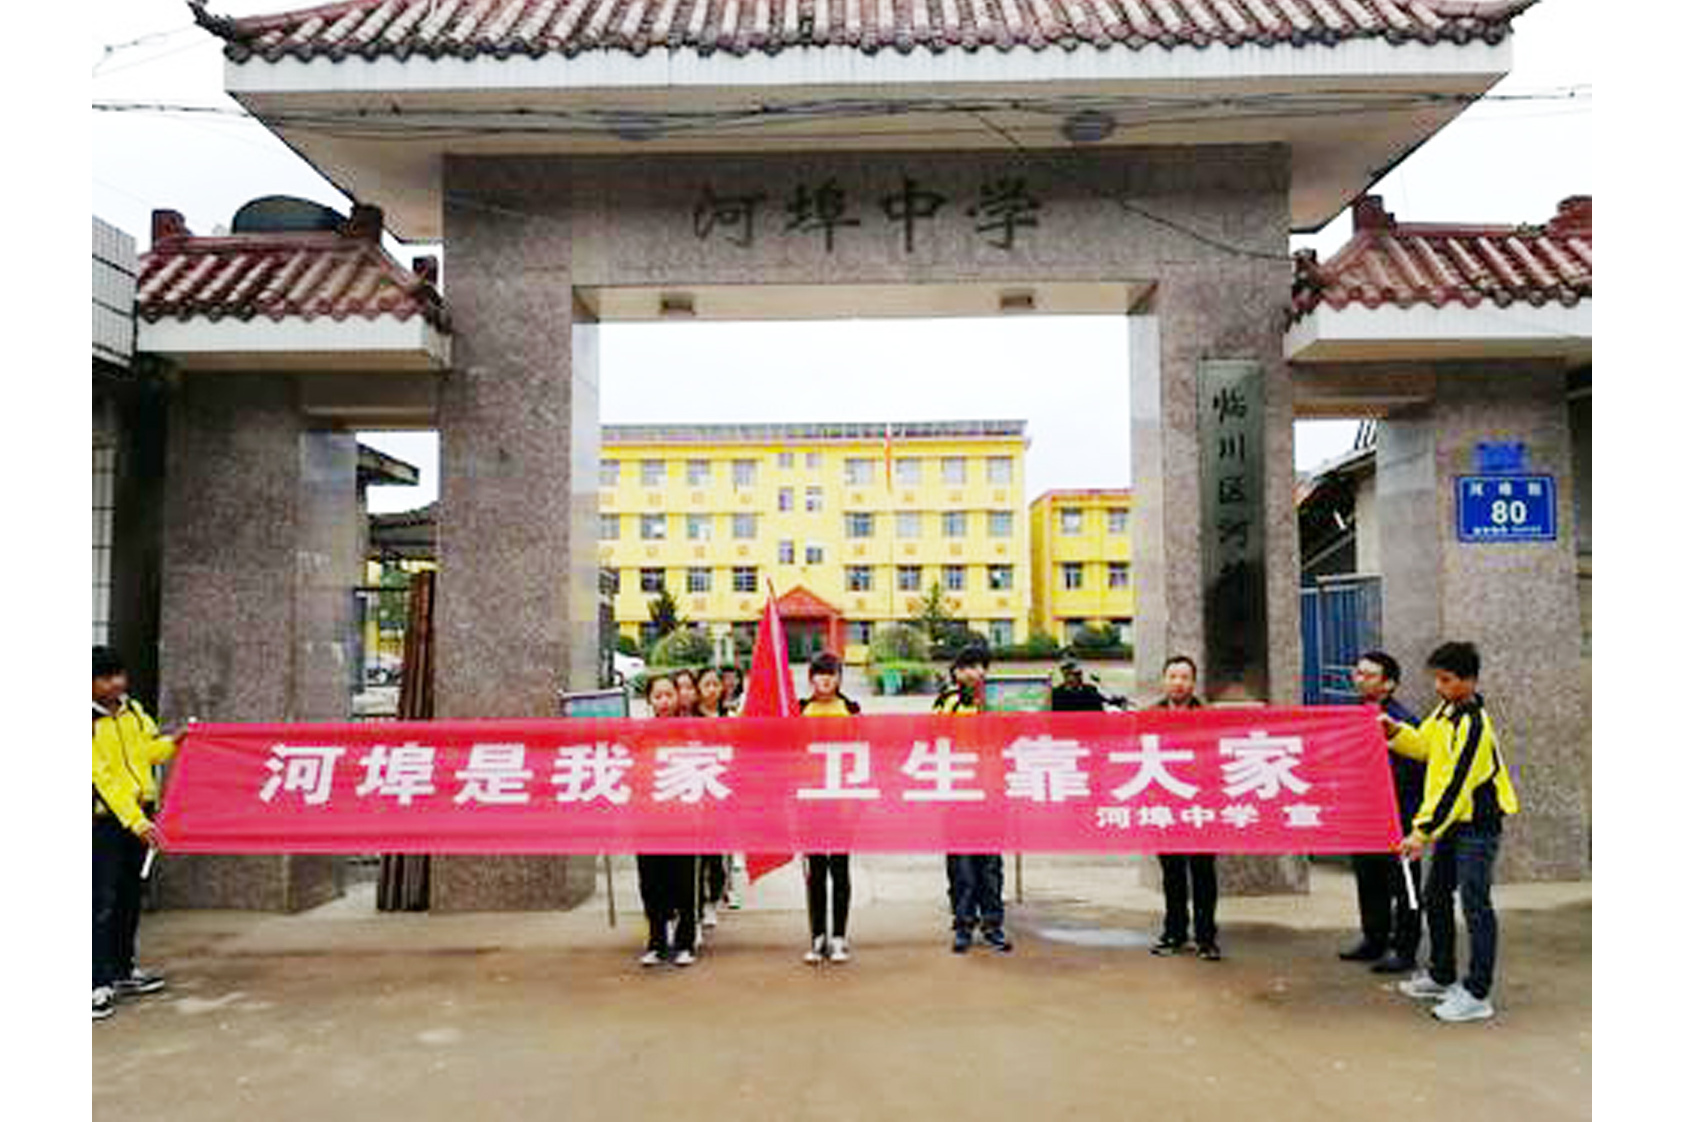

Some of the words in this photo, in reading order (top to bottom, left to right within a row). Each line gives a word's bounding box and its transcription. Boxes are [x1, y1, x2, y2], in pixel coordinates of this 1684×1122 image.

[693, 177, 1042, 251] 河埠中学
[1491, 499, 1527, 524] 80
[258, 742, 734, 806] 河埠是我家
[796, 731, 1313, 801] 卫生靠大家
[1095, 804, 1262, 829] 河埠中学
